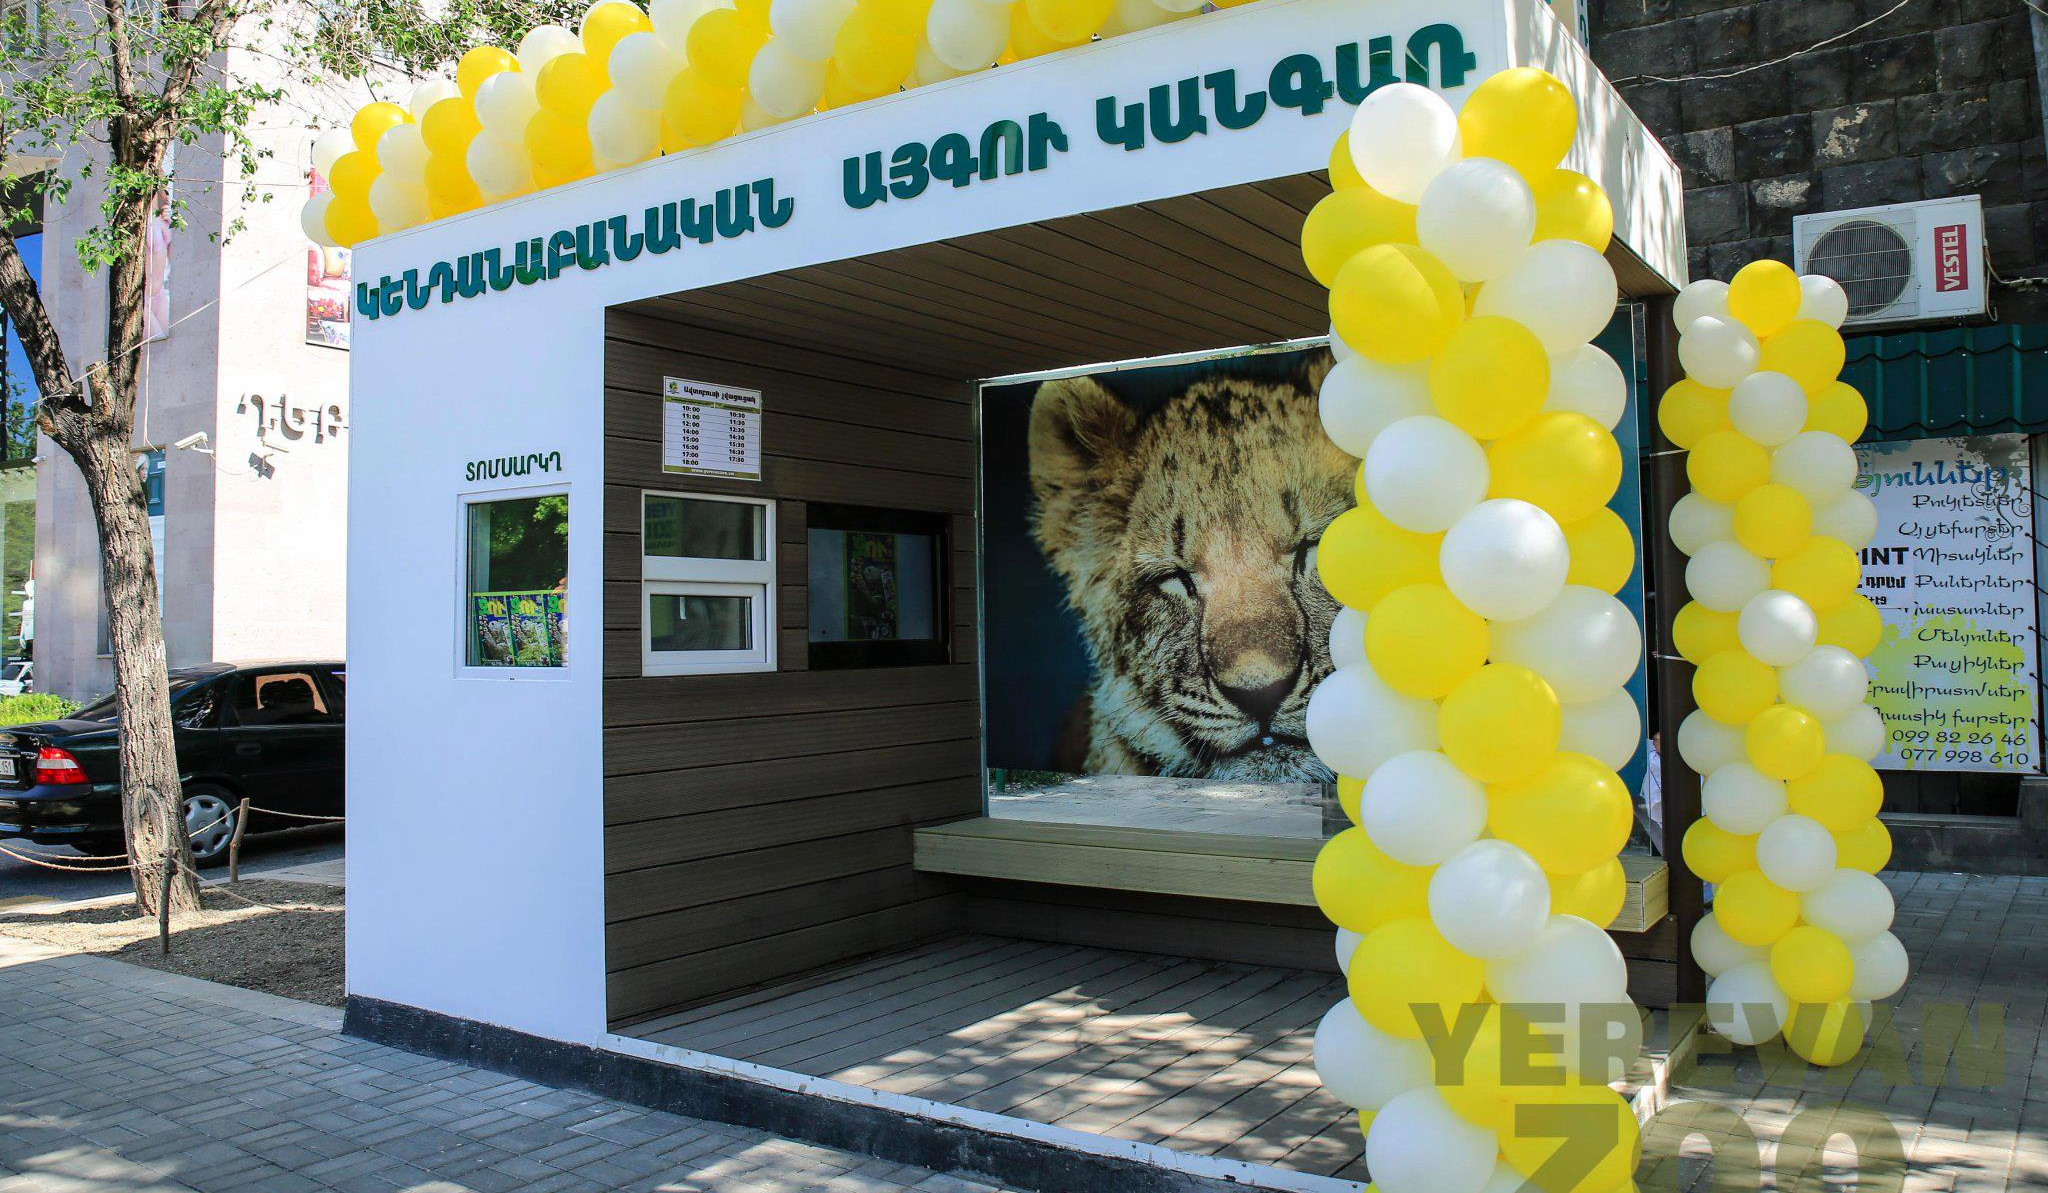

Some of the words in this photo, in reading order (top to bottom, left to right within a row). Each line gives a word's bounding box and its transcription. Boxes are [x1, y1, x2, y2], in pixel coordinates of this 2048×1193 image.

[356, 177, 794, 321] ԿԵՆԴԱՆԱԲԱՆԱԿԱՆ
[843, 111, 1069, 210] ԱՅԳՈՒ
[1941, 225, 1960, 291] VESTEL
[465, 451, 562, 481] ՏՈՄՍԱՐԿՂ
[1855, 547, 1909, 566] INT
[1912, 547, 2024, 566] Պիտակներ
[1915, 575, 2024, 592] Բաներներ
[1917, 628, 2025, 647] Մենյուներ
[1913, 654, 2025, 674] Բացիկներ
[1892, 729, 1930, 743] 099
[1935, 731, 1961, 744] 82
[1968, 732, 1993, 745] 26
[2000, 733, 2026, 746] 46
[1900, 748, 1938, 761] 077
[1945, 750, 1982, 763] 998
[1989, 751, 2029, 765] 610
